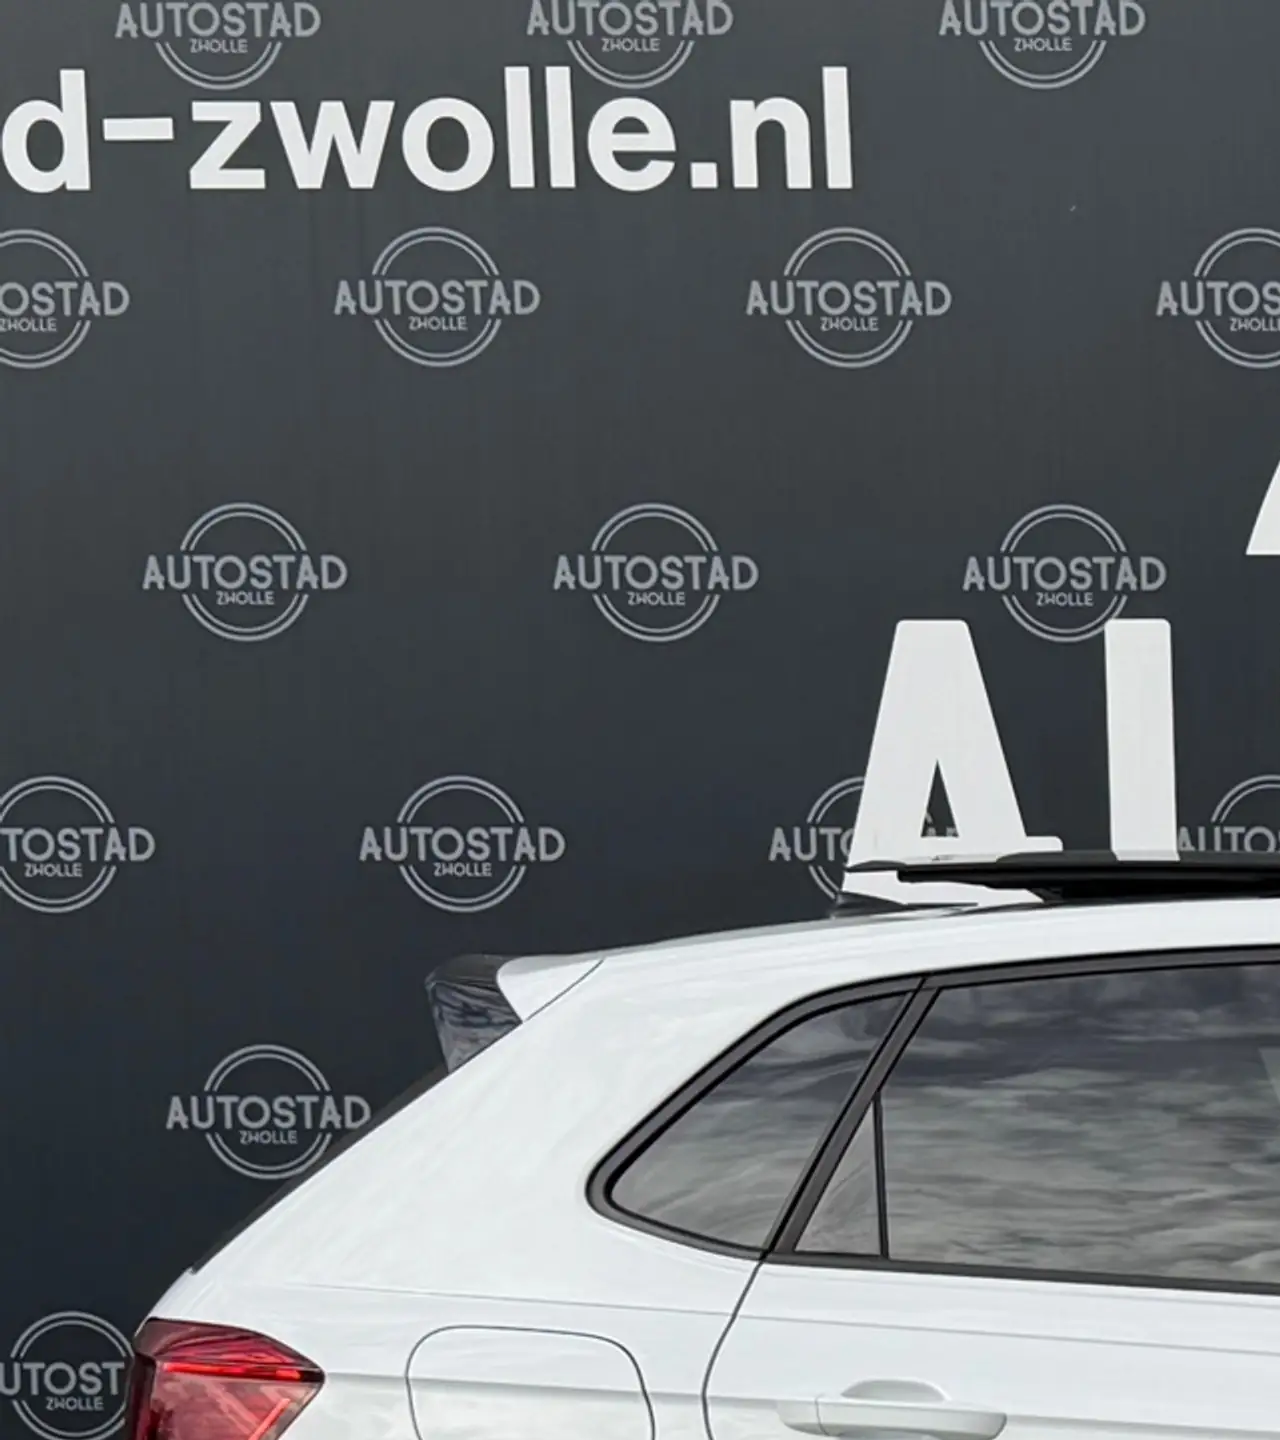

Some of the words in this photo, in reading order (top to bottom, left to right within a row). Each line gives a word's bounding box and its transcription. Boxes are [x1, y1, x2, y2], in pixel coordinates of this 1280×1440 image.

[114, 1, 322, 37] AUTOSTAD
[526, 0, 734, 36] AUTOSTAD
[938, 0, 1146, 36] AUTOSTAD
[2, 66, 852, 192] d-zwolle.nl
[333, 279, 541, 315] AUTOSTAD
[745, 280, 953, 316] AUTOSTAD
[141, 554, 349, 590] AUTOSTAD
[552, 554, 760, 590] AUTOSTAD
[963, 556, 1167, 591] AUTOSTAD
[358, 826, 566, 862] AUTOSTAD
[166, 1094, 370, 1129] AUTOSTAD
